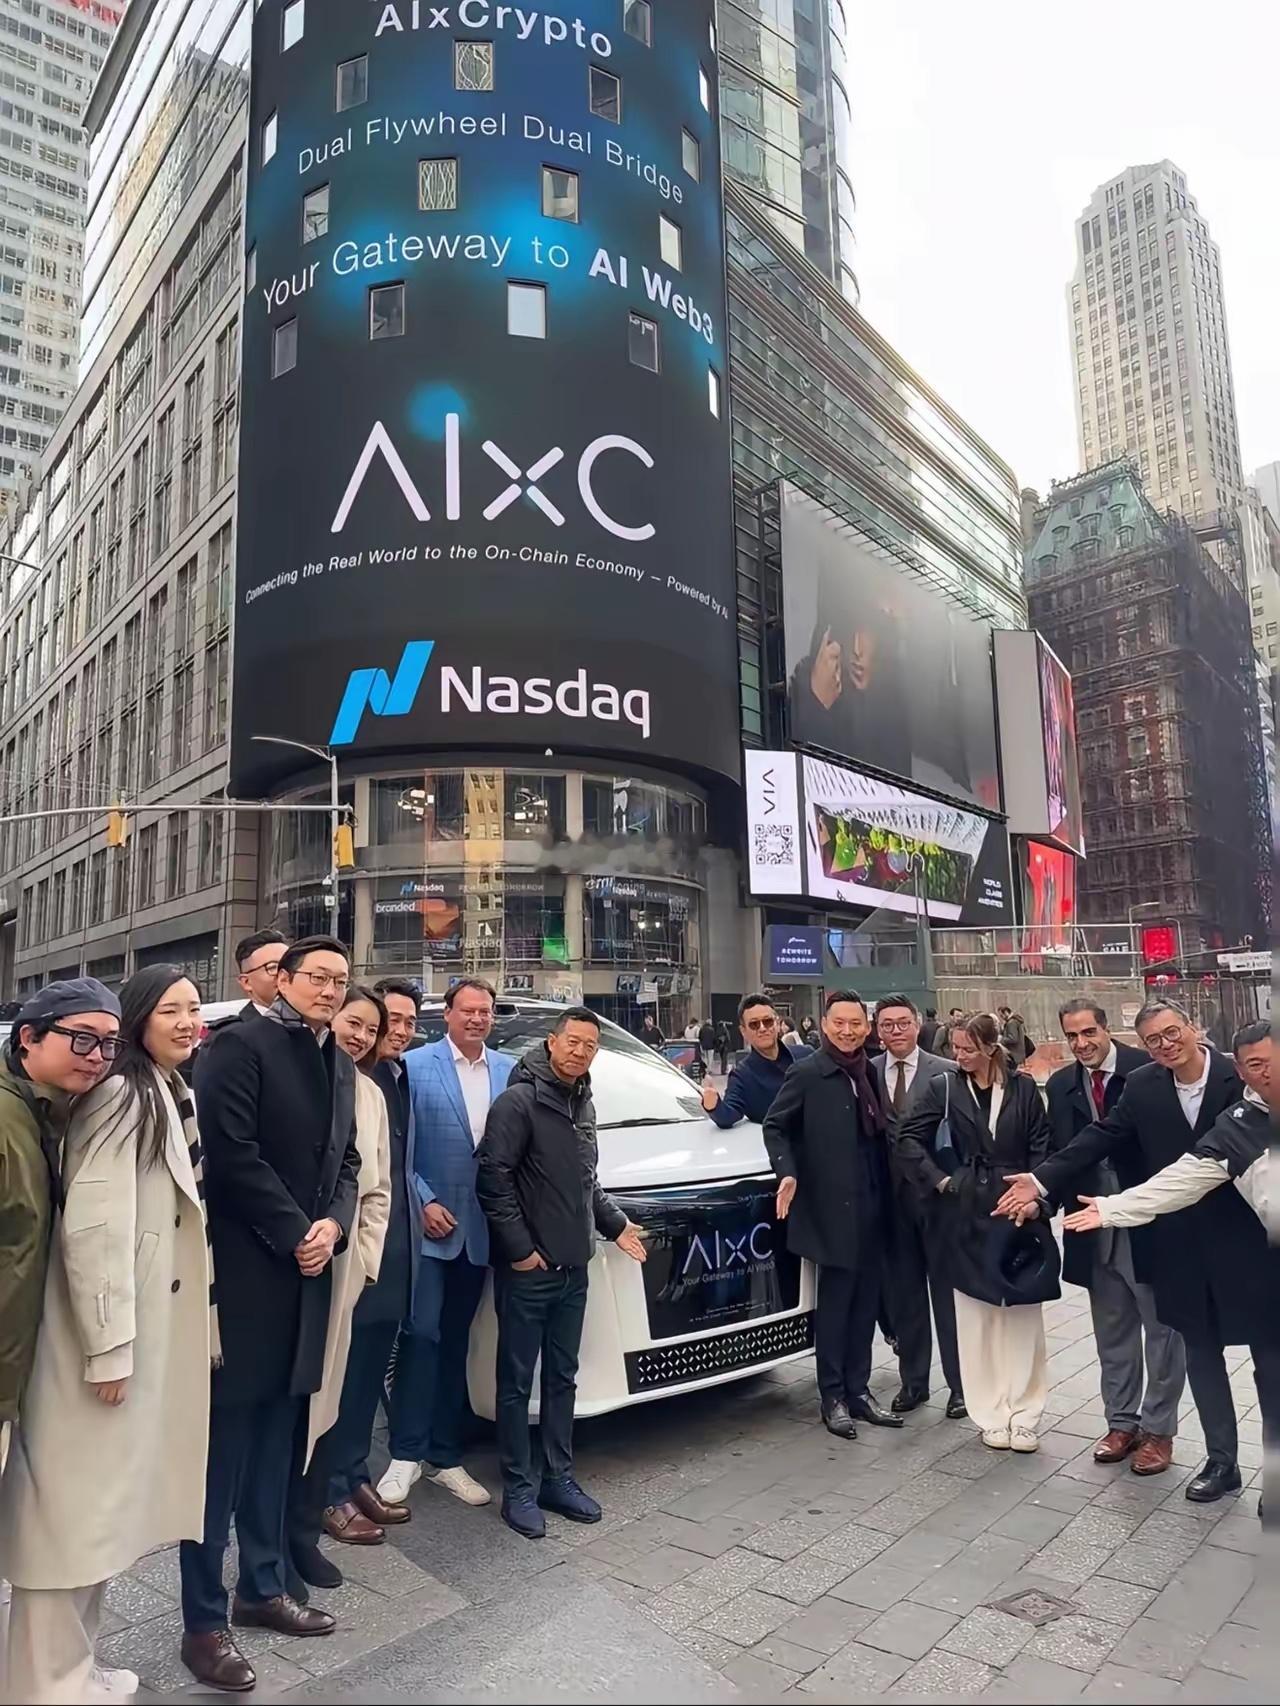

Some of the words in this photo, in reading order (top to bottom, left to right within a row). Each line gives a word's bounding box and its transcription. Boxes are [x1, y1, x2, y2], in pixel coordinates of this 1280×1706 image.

[375, 0, 612, 58] AIxCrypto
[299, 128, 352, 174] Dual
[366, 113, 506, 144] Flywheel
[524, 116, 591, 155] Dual
[606, 140, 683, 204] Bridge
[263, 261, 319, 314] Your
[333, 233, 512, 276] Gateway
[532, 236, 569, 268] to
[588, 249, 627, 288] AI
[641, 267, 714, 345] Web3
[245, 570, 298, 604] Connecting
[302, 562, 323, 578] the
[328, 552, 363, 571] Real
[368, 546, 417, 564] World
[425, 546, 441, 559] to
[450, 545, 477, 559] the
[485, 545, 568, 565] On-Chain
[575, 553, 645, 581] Economy
[667, 576, 710, 605] Powered
[711, 598, 721, 614] by
[441, 666, 651, 739] Nasdaq
[375, 901, 416, 913] branded
[682, 1277, 700, 1287] Your
[702, 1271, 734, 1283] Gateway
